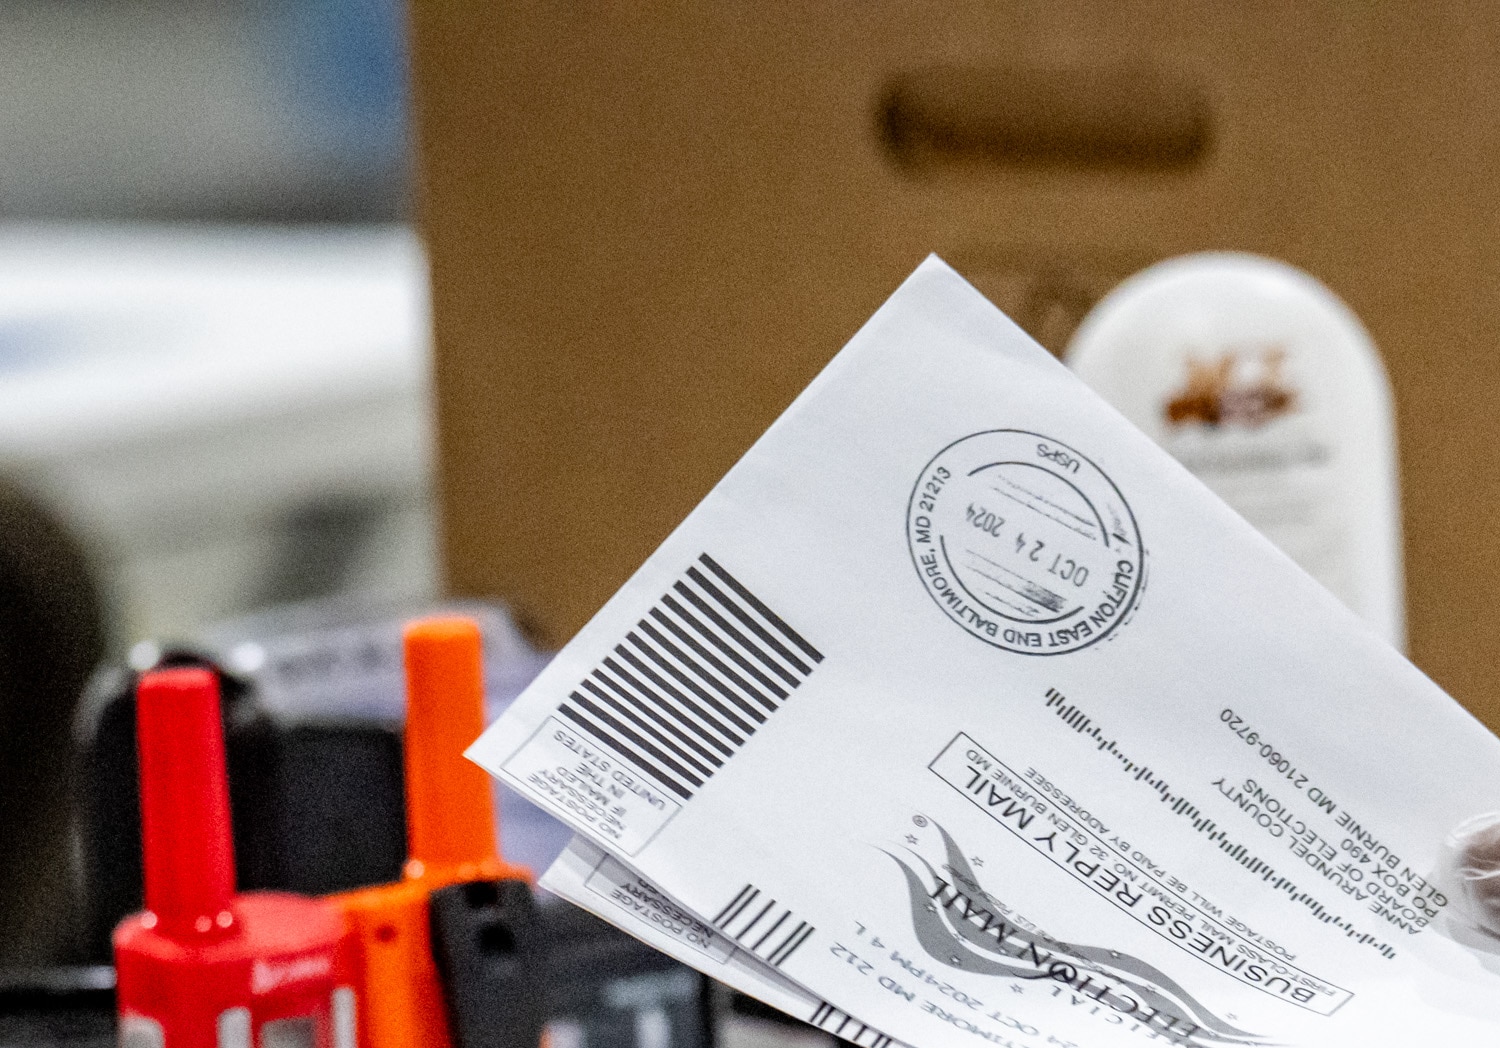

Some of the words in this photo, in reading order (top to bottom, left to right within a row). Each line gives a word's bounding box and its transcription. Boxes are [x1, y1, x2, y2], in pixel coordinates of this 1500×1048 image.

[1036, 443, 1081, 474] USPS
[919, 466, 951, 513] 21213
[916, 515, 931, 544] MD
[966, 502, 1005, 538] 2024
[1047, 553, 1090, 588] OCT
[920, 548, 999, 637] BALTIMORE,
[1090, 560, 1134, 624] CLIFTON
[1004, 628, 1042, 647] END
[1048, 620, 1094, 647] EAST
[553, 730, 612, 772] STATES
[965, 748, 993, 771] MD
[1219, 708, 1309, 790] 21060-9720
[556, 766, 610, 806] MAILED
[576, 762, 609, 786] THE
[608, 784, 626, 799] IN
[612, 770, 667, 811] UNITED
[991, 769, 1048, 815] BURNIE
[527, 774, 596, 823] POSTAGE
[538, 768, 627, 831] NECESSARY
[611, 804, 627, 818] IF
[965, 765, 1036, 830] MAIL
[1024, 766, 1111, 835] ADDRESSEE
[1212, 777, 1284, 838] COUNTY
[1306, 787, 1337, 814] MD
[599, 822, 623, 839] NO
[1048, 812, 1090, 846] GLEN
[1242, 779, 1337, 862] ELECTIONS
[1089, 846, 1111, 862] 32
[1108, 834, 1131, 853] BY
[1335, 810, 1401, 870] BURNIE
[1340, 837, 1372, 866] 490
[1034, 831, 1144, 908] REPLY
[1113, 857, 1140, 883] NO.
[1132, 850, 1167, 878] PAID
[1289, 835, 1369, 902] ARUNDEL
[1336, 861, 1365, 883] OF
[1372, 863, 1411, 898] BOX
[1138, 882, 1196, 922] PERMIT
[1167, 876, 1188, 894] BE
[1400, 867, 1449, 909] GLEN
[611, 888, 685, 936] POSTAGE
[620, 881, 714, 939] NECESSARY
[928, 875, 1018, 944] MAIL
[1192, 890, 1223, 918] WILL
[1365, 881, 1430, 929] BOARD
[1368, 901, 1422, 936] ANNE
[1412, 896, 1440, 919] PO
[686, 932, 712, 949] NO
[870, 936, 885, 949] 4
[1200, 918, 1233, 946] MAIL
[1225, 915, 1297, 961] POSTAGE
[830, 940, 875, 977] 212
[1147, 906, 1317, 1004] BUSINESS
[1235, 944, 1336, 997] FIRST-CLASS
[878, 975, 916, 1003] MD
[1017, 941, 1201, 1038] ELECTION
[986, 1011, 1040, 1036] OCT
